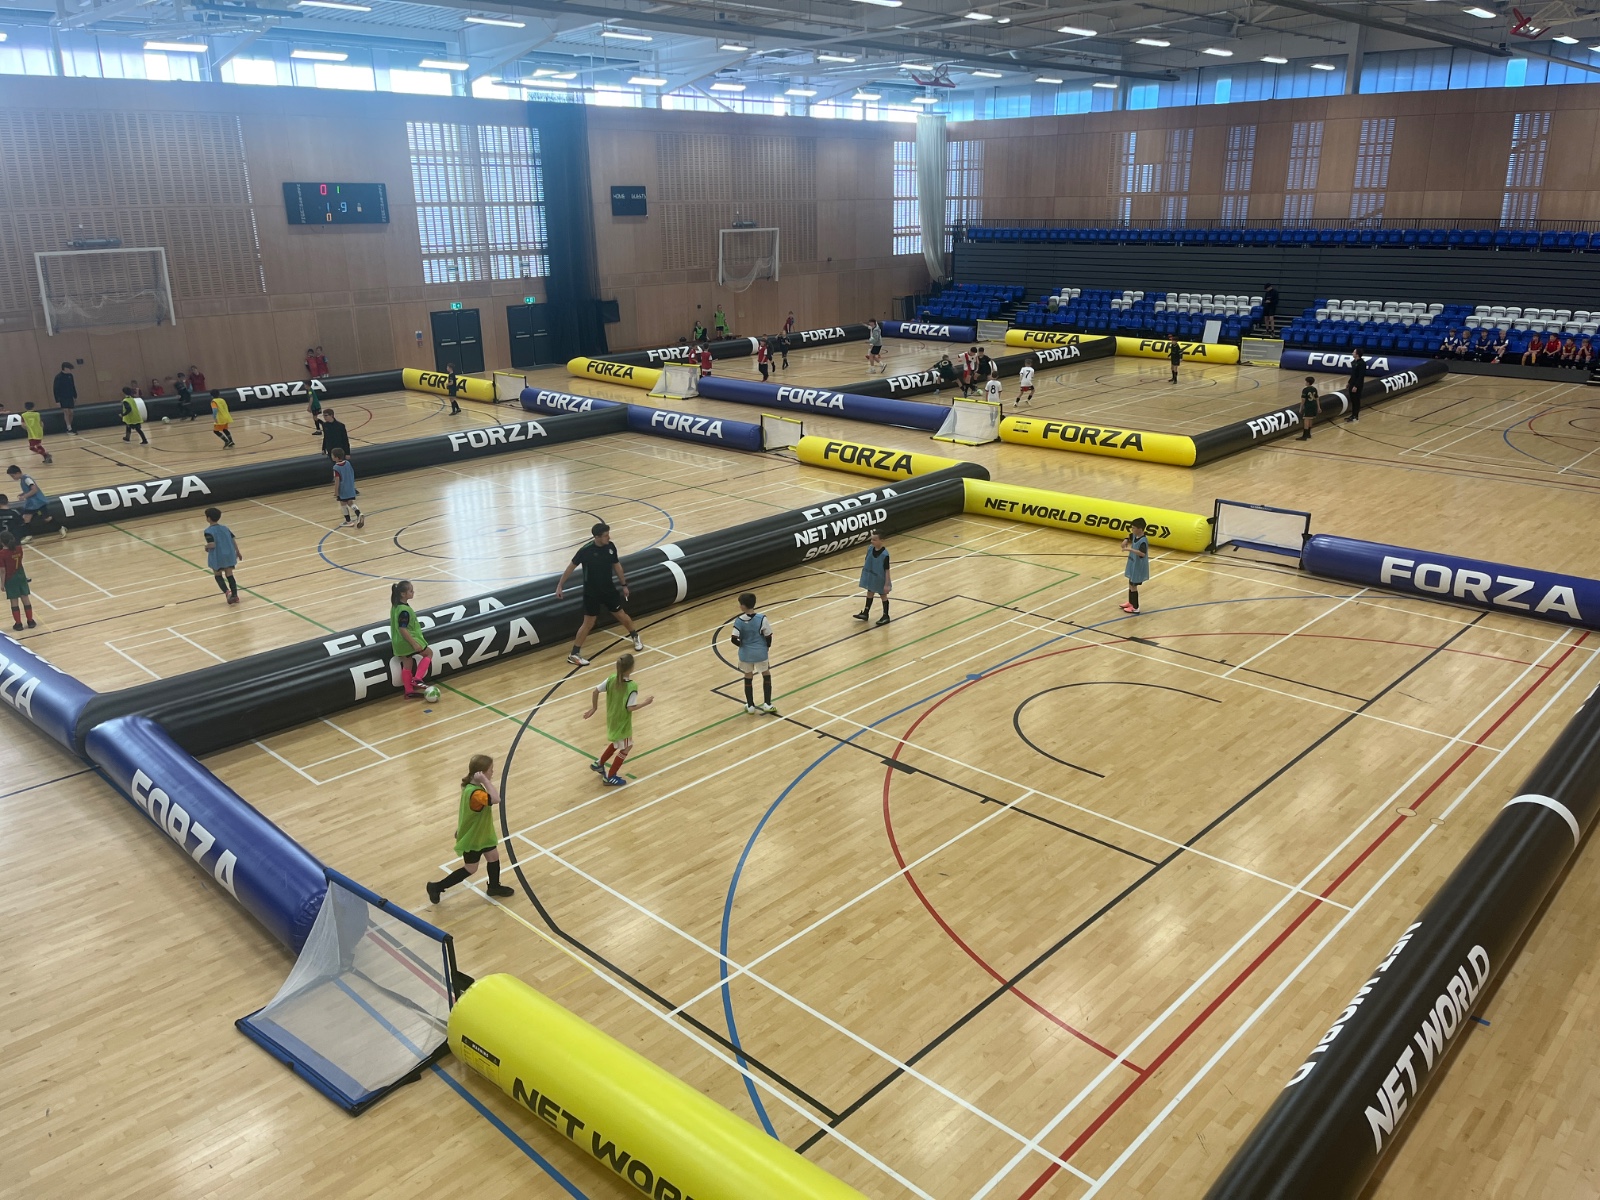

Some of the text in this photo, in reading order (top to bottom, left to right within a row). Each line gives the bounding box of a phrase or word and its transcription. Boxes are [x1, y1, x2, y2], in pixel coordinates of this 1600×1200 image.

[800, 327, 846, 342] FORZA
[900, 322, 950, 336] FORZA
[1024, 332, 1080, 344] FORZA
[1036, 346, 1080, 364] FORZA
[419, 372, 468, 394] FORA
[586, 360, 634, 380] FORZA
[886, 370, 944, 393] FORZA
[1025, 370, 1030, 379] 7
[1380, 370, 1419, 394] FORZA
[236, 379, 328, 402] FORZA
[536, 390, 594, 412] FORZA
[776, 386, 845, 410] FORZA
[990, 385, 996, 394] 8
[448, 421, 548, 452] FORZA
[651, 410, 724, 438] FORZA
[1042, 422, 1144, 452] FORZA
[1246, 409, 1300, 440] FORZA
[824, 441, 914, 475] FORZA
[58, 475, 212, 518] FORZA
[794, 508, 888, 548] NET WORLD
[984, 497, 1160, 538] NET WORLD SPORS
[802, 530, 869, 562] SPORTS
[1380, 556, 1583, 620] FORZA
[350, 617, 540, 700] FORZA
[131, 769, 240, 901] FORZA
[1364, 945, 1490, 1154] NET WORLD
[512, 1076, 695, 1200] NET WOR
